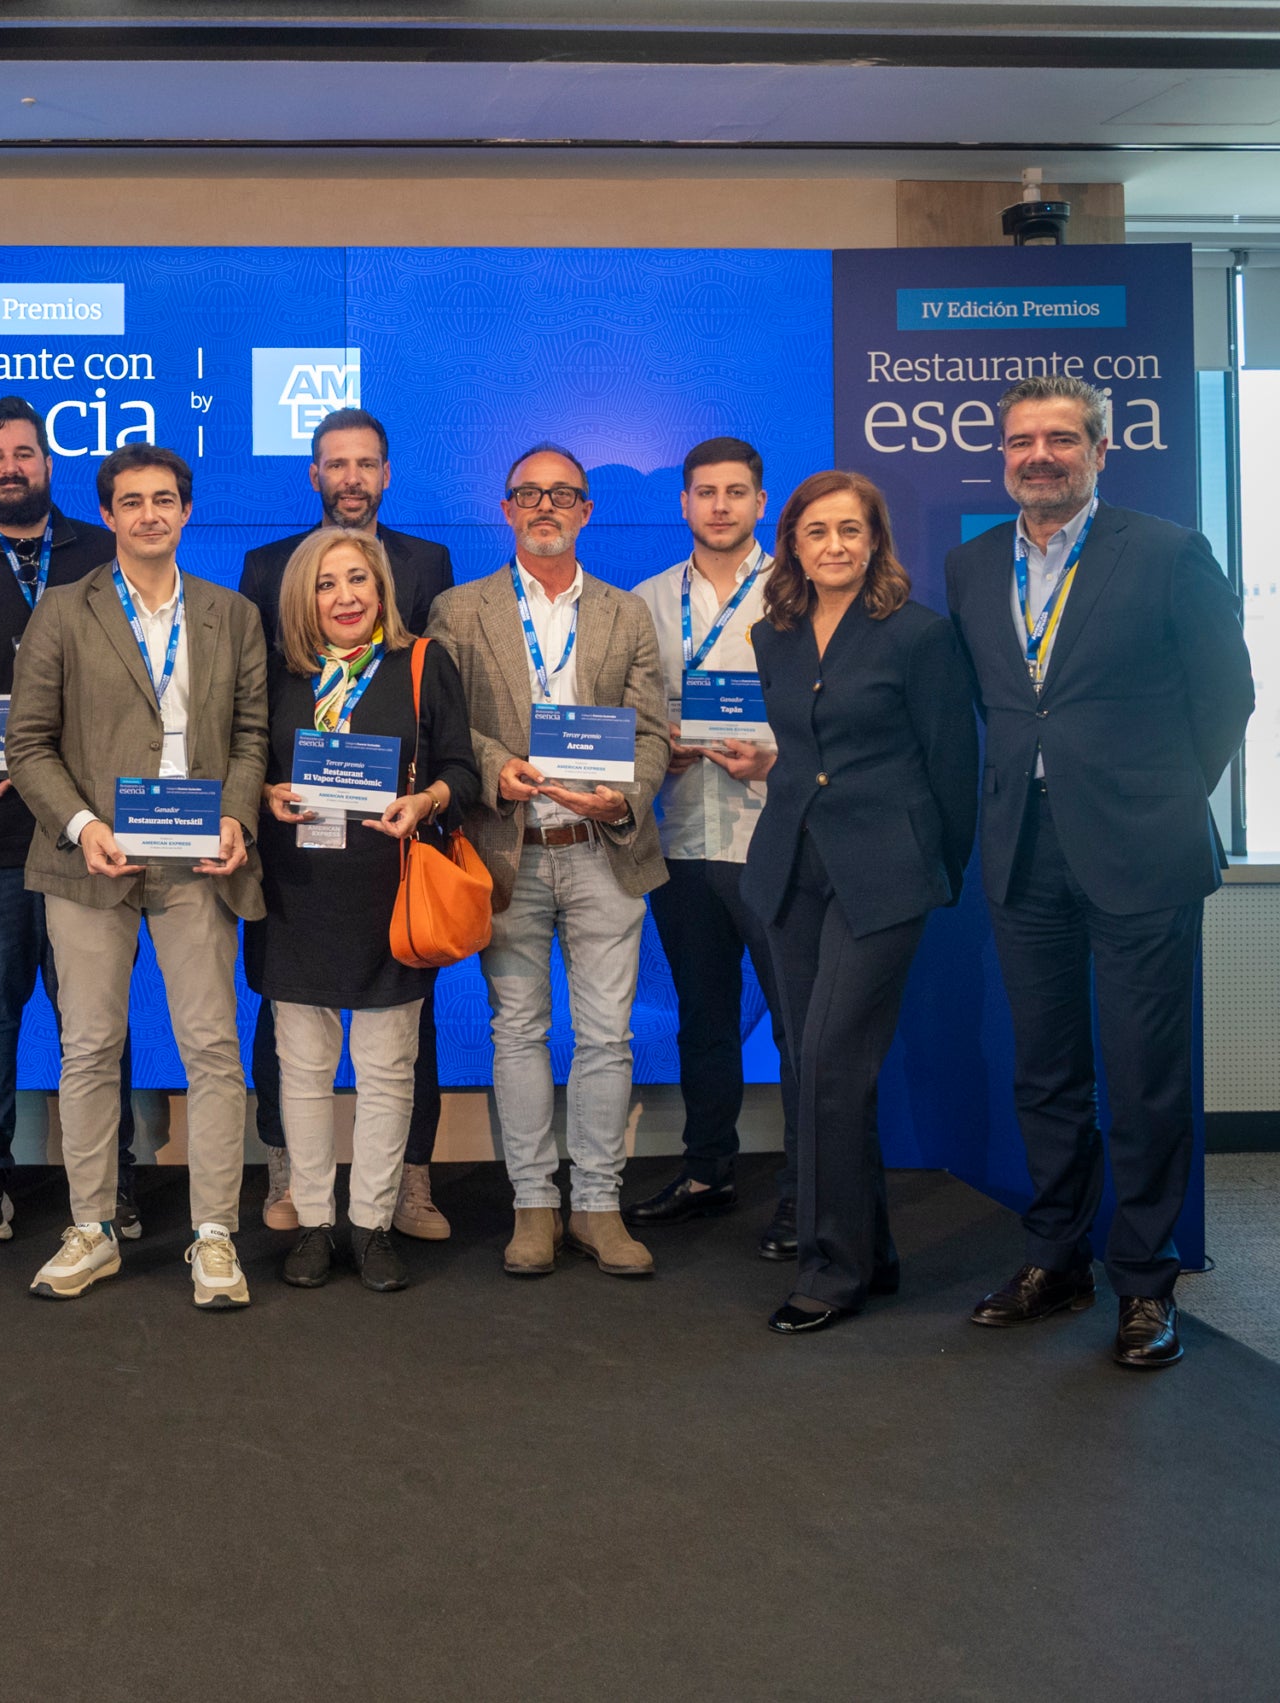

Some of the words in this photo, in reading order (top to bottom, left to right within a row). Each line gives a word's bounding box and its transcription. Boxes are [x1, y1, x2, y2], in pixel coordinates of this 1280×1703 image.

[0, 298, 102, 320] Premios
[921, 302, 944, 319] IV
[947, 300, 1018, 319] Edición
[1022, 300, 1100, 318] Premios
[83, 352, 156, 380] con
[866, 351, 1084, 382] Restaurante
[1093, 354, 1162, 380] con
[190, 390, 213, 412] by
[864, 388, 1168, 452] eseia
[312, 775, 334, 783] Vapor
[323, 768, 364, 778] Restaurant
